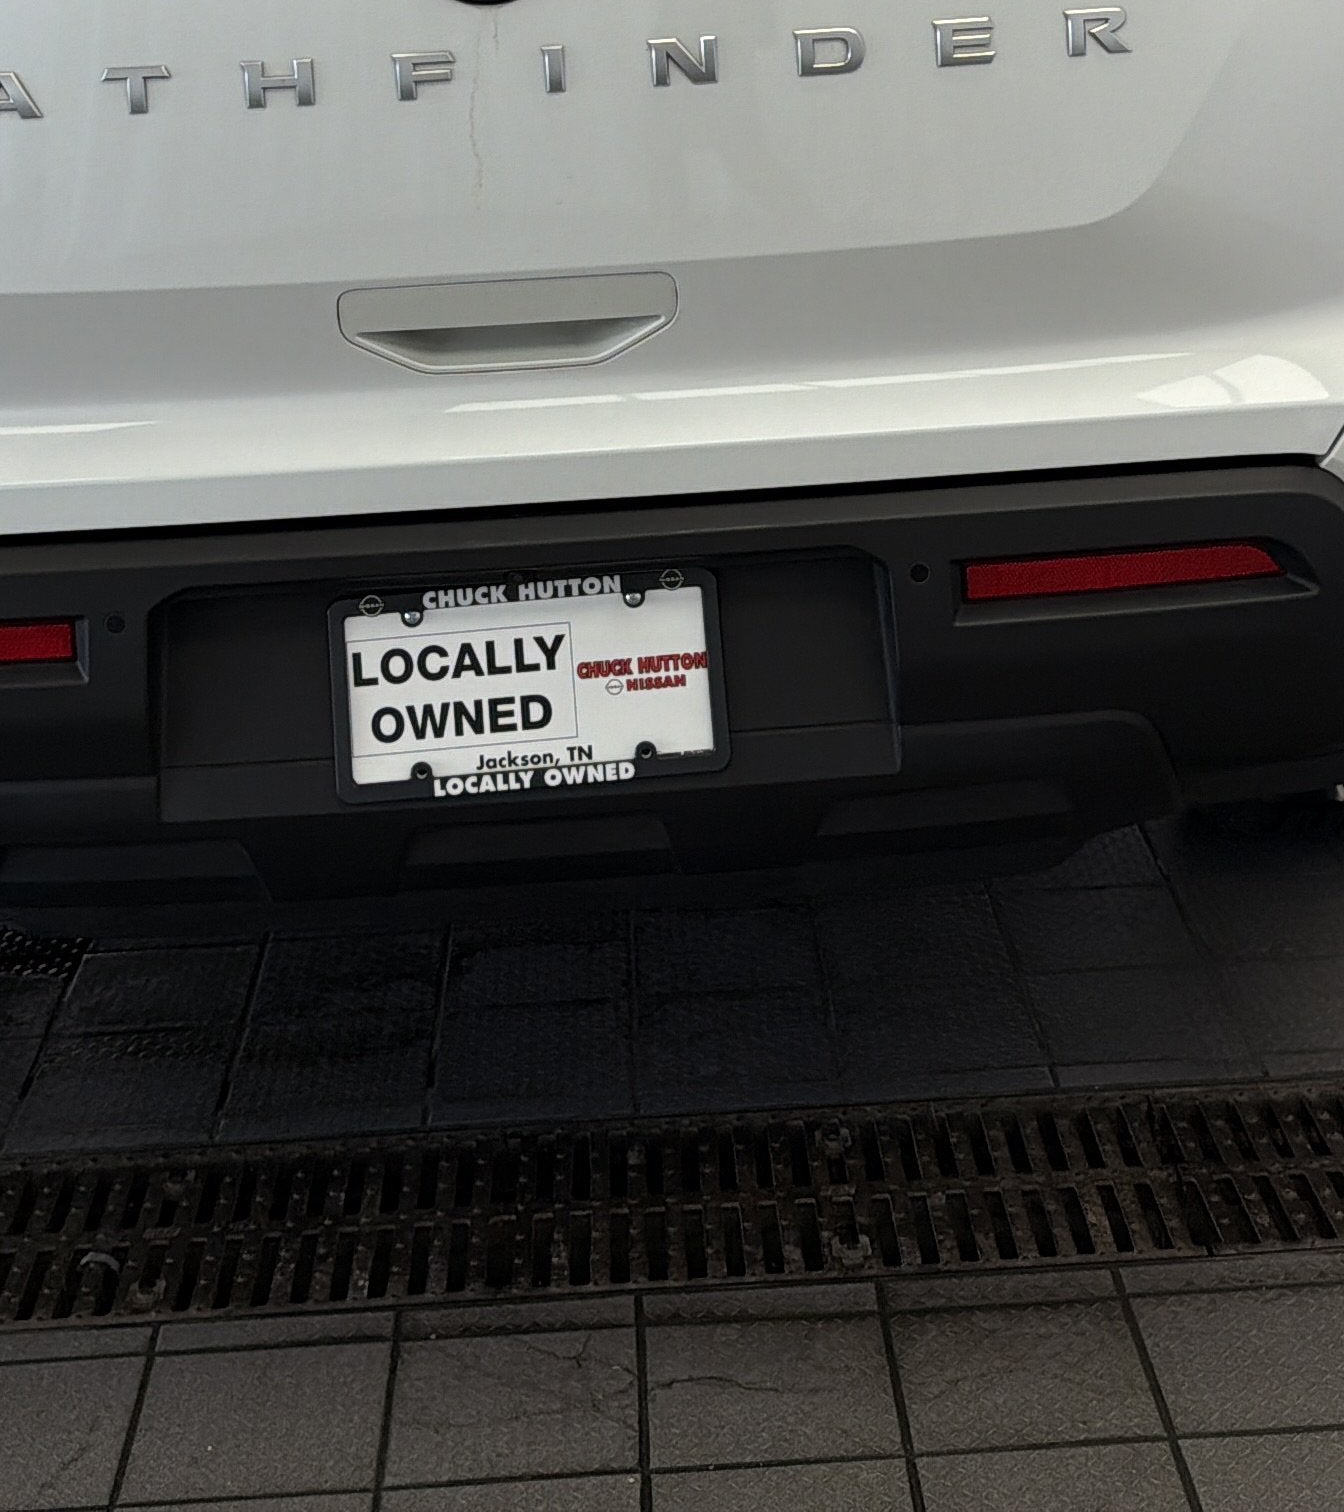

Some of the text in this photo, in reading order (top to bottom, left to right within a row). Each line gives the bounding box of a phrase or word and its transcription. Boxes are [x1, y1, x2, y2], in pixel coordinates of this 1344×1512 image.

[422, 575, 622, 610] CHUCK HUTTON
[352, 634, 566, 688] LOCALLY
[576, 651, 709, 679] CHUCK HUTTON
[626, 674, 687, 692] NISSAN
[371, 694, 553, 744] OWNED
[475, 745, 594, 771] Jackson, TN
[434, 761, 636, 798] LOCALLY OWNED
